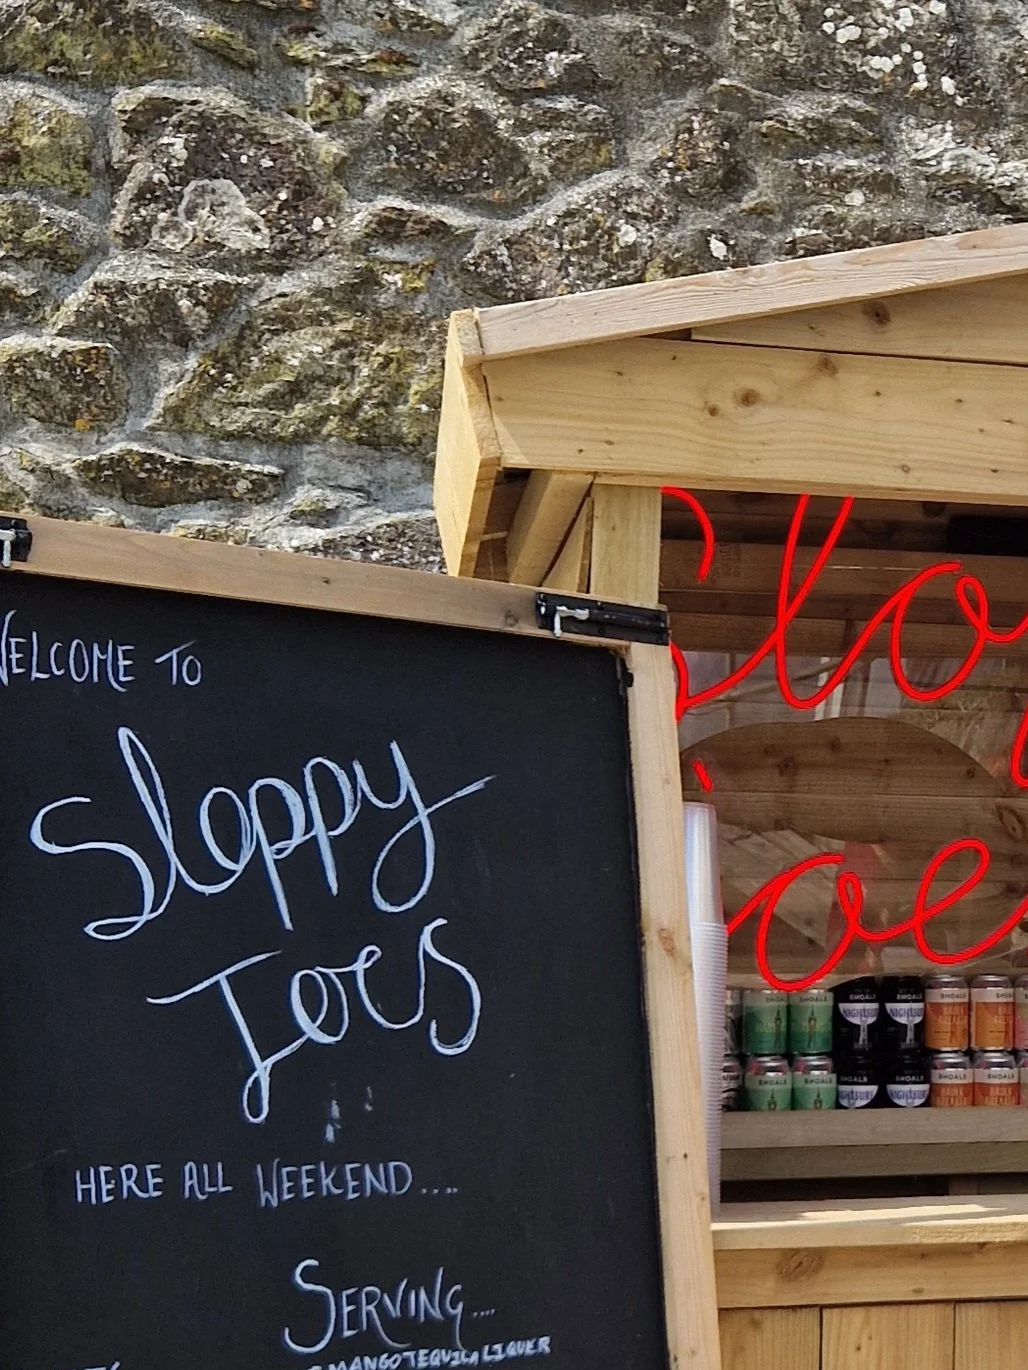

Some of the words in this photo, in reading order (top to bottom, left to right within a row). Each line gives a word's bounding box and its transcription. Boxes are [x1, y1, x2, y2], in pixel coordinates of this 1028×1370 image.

[154, 640, 201, 685] TO
[29, 727, 497, 939] Sloppy
[75, 1163, 164, 1205] HERE
[184, 1160, 233, 1200] ALL
